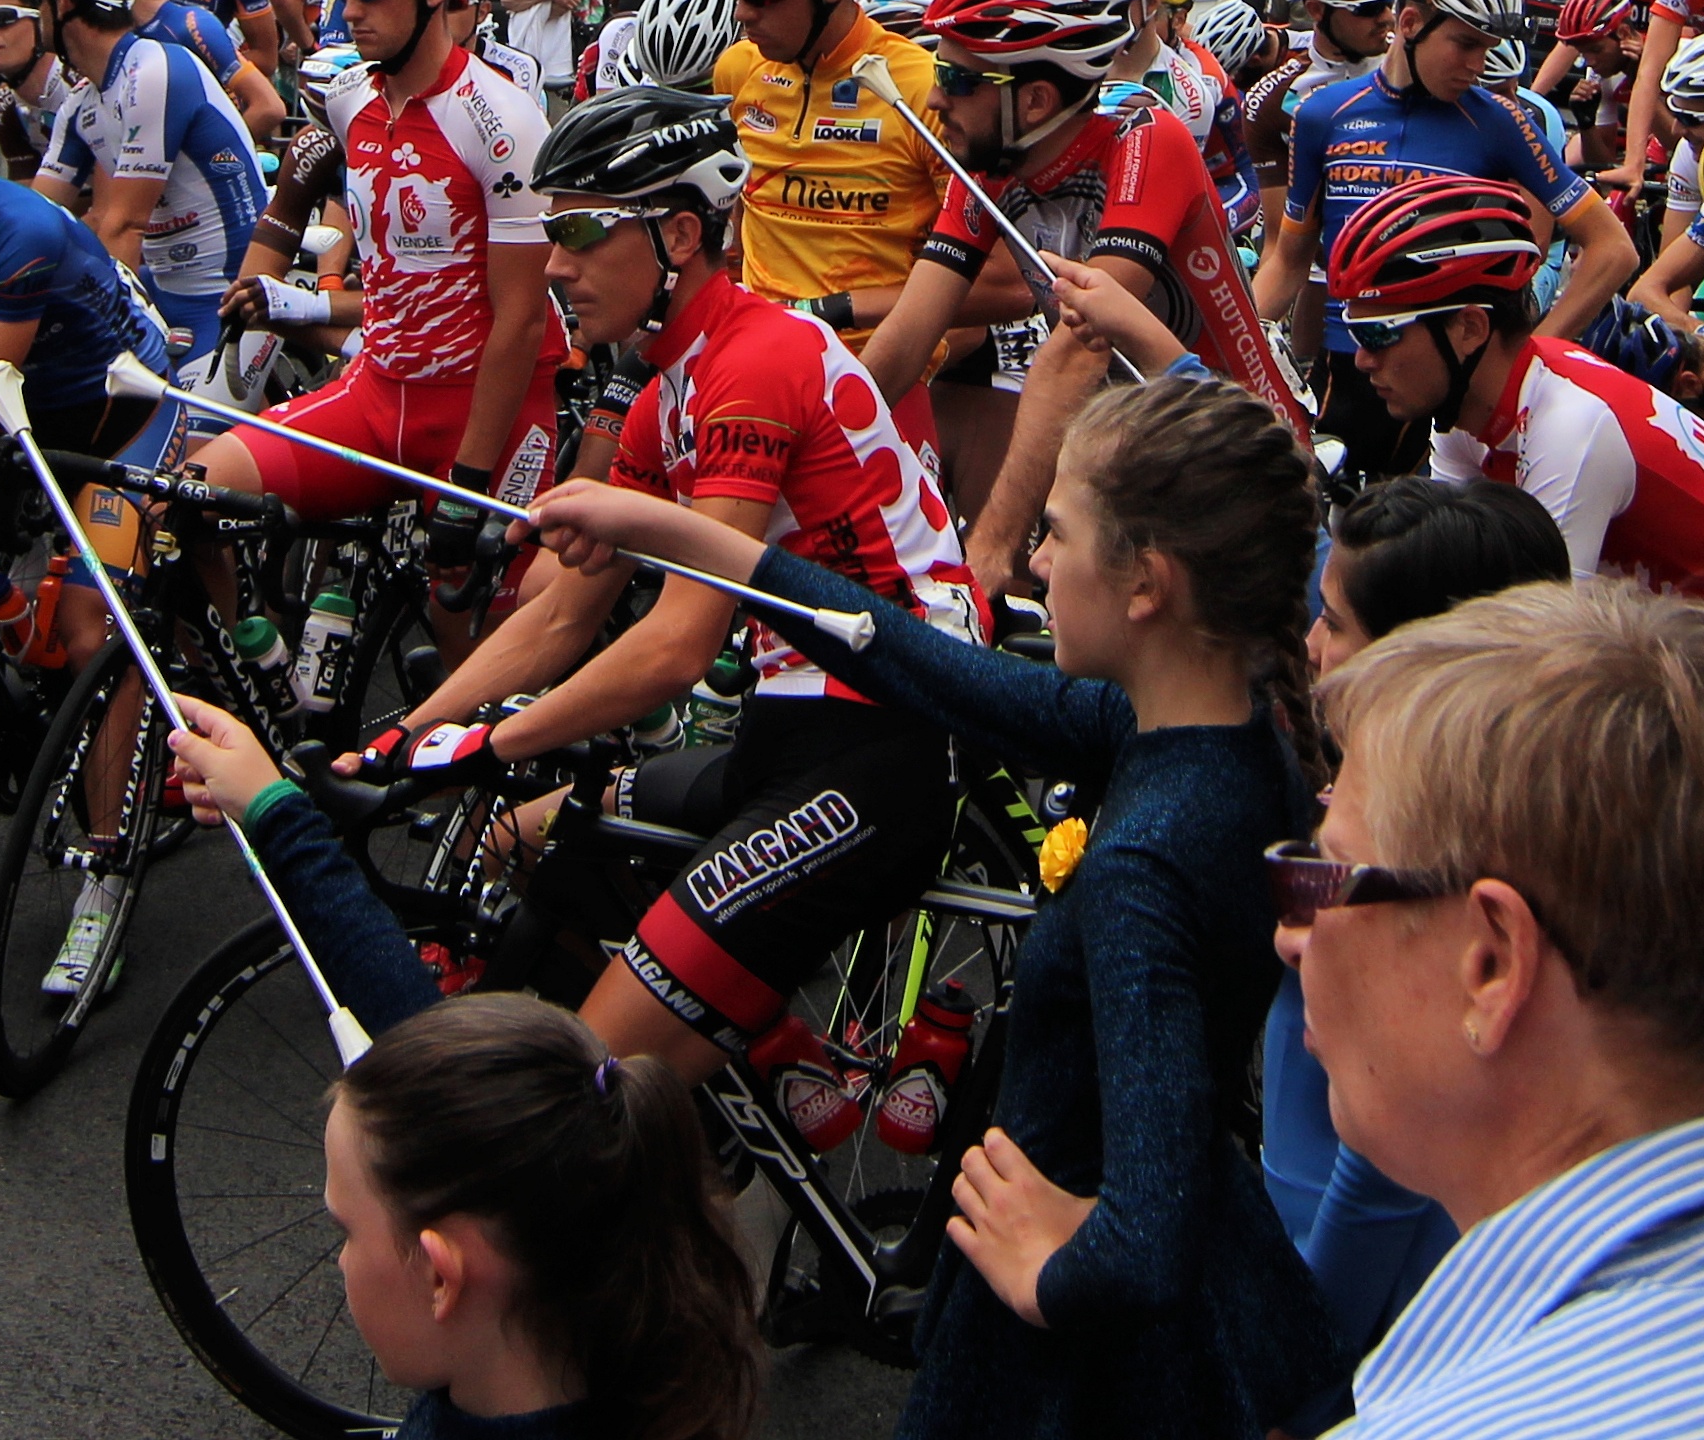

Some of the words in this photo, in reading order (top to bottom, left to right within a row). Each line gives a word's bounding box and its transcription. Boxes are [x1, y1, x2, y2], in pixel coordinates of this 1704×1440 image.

[470, 89, 504, 138] VENDÉE
[814, 127, 860, 142] LOOK
[493, 139, 509, 158] U
[1326, 141, 1388, 156] LOOK
[1550, 188, 1581, 213] OPEL
[393, 236, 444, 249] VENDÉE
[500, 452, 536, 506] ENDÉE
[184, 482, 205, 499] 35
[686, 789, 859, 913] HALGAND
[802, 824, 878, 875] personnalisation
